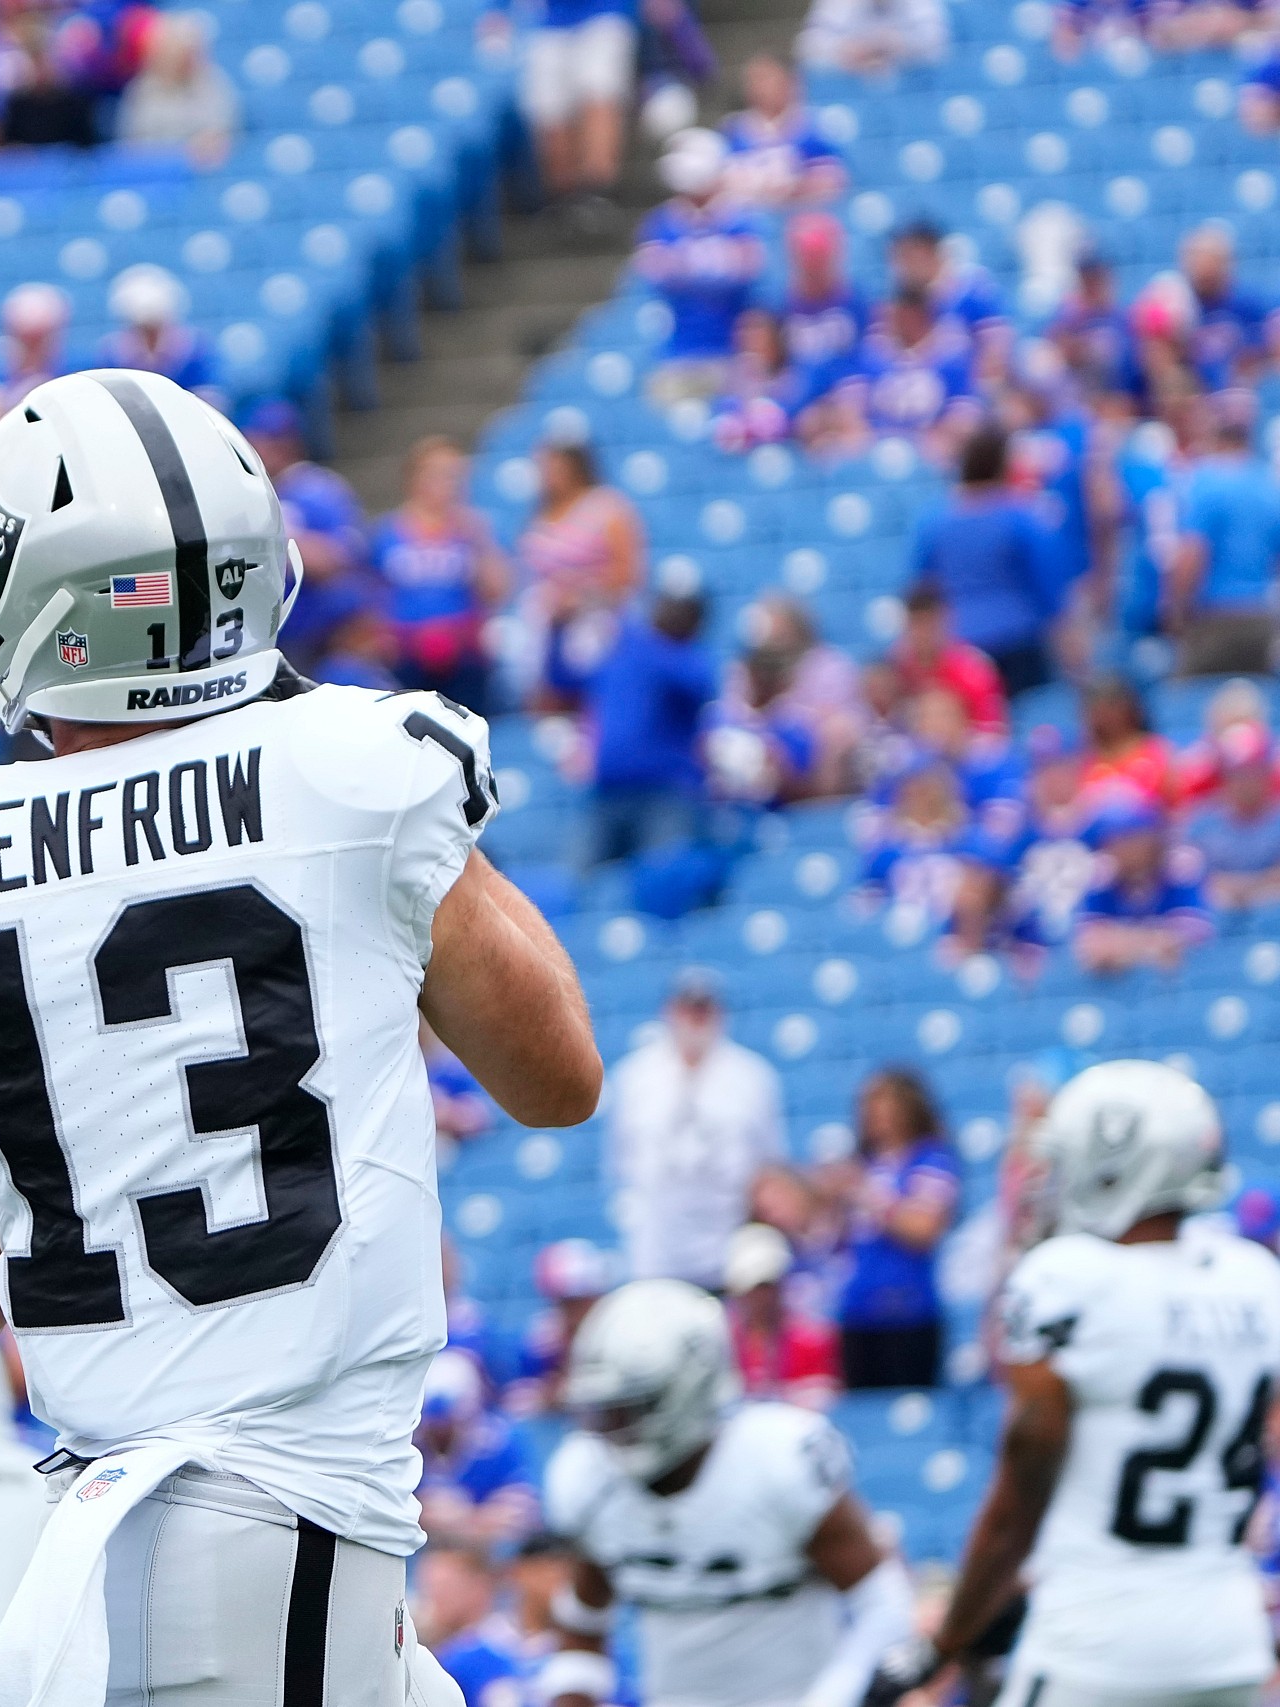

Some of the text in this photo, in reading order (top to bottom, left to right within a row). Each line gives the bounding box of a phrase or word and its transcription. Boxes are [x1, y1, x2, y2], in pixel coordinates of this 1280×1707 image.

[220, 565, 244, 587] AL
[61, 645, 86, 664] NFL
[126, 670, 248, 710] RAIDERS
[80, 1480, 111, 1499] NFL
